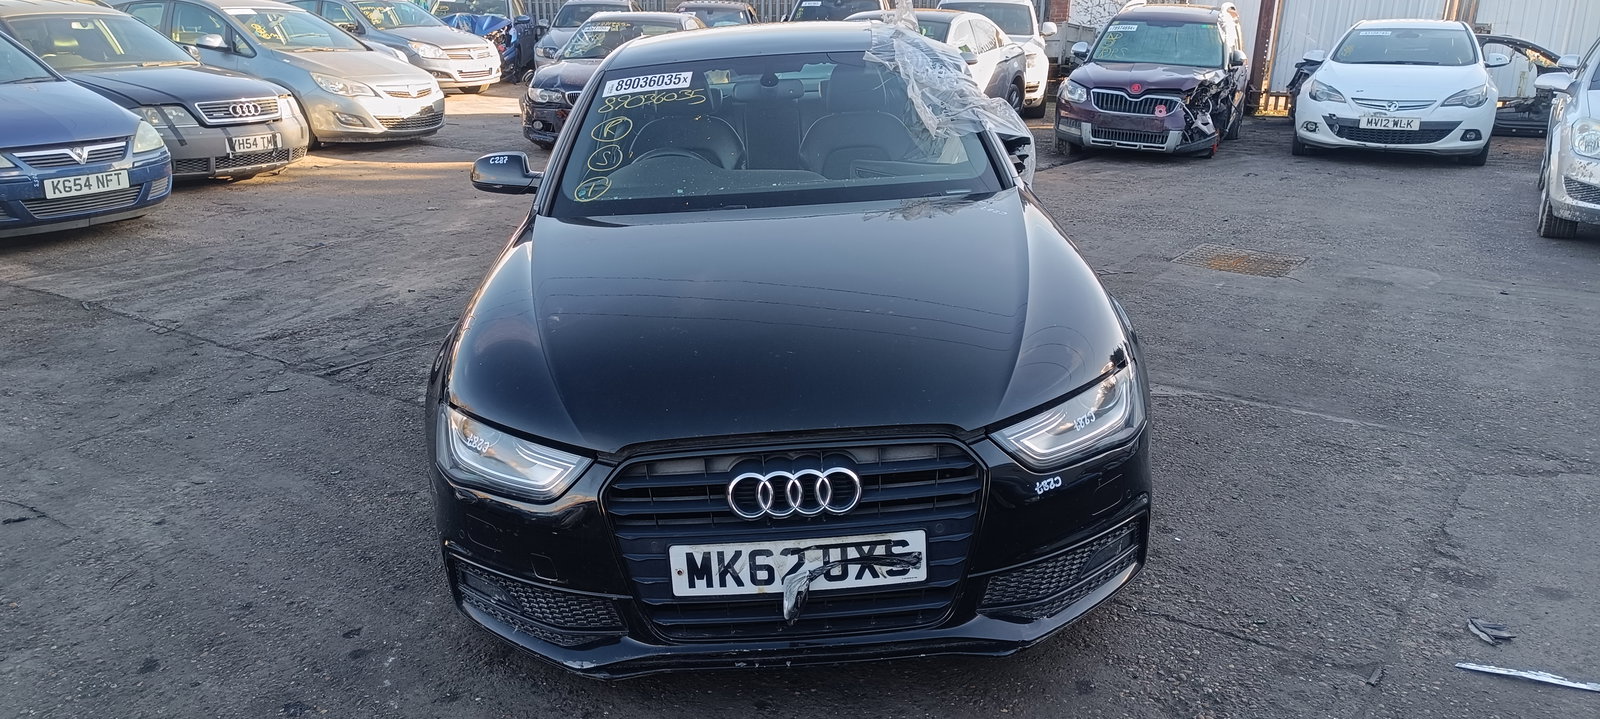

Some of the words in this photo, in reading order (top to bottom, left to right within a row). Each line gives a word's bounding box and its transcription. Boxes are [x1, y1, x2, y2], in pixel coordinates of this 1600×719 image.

[598, 89, 706, 113] 89036035
[1366, 118, 1390, 128] MV12
[1392, 119, 1413, 129] WLK
[490, 155, 508, 164] C287
[51, 176, 93, 195] KG54
[95, 172, 122, 189] NFT
[1073, 410, 1096, 432] C287
[466, 433, 490, 453] C287
[1034, 476, 1062, 495] C287
[685, 547, 806, 589] MK62
